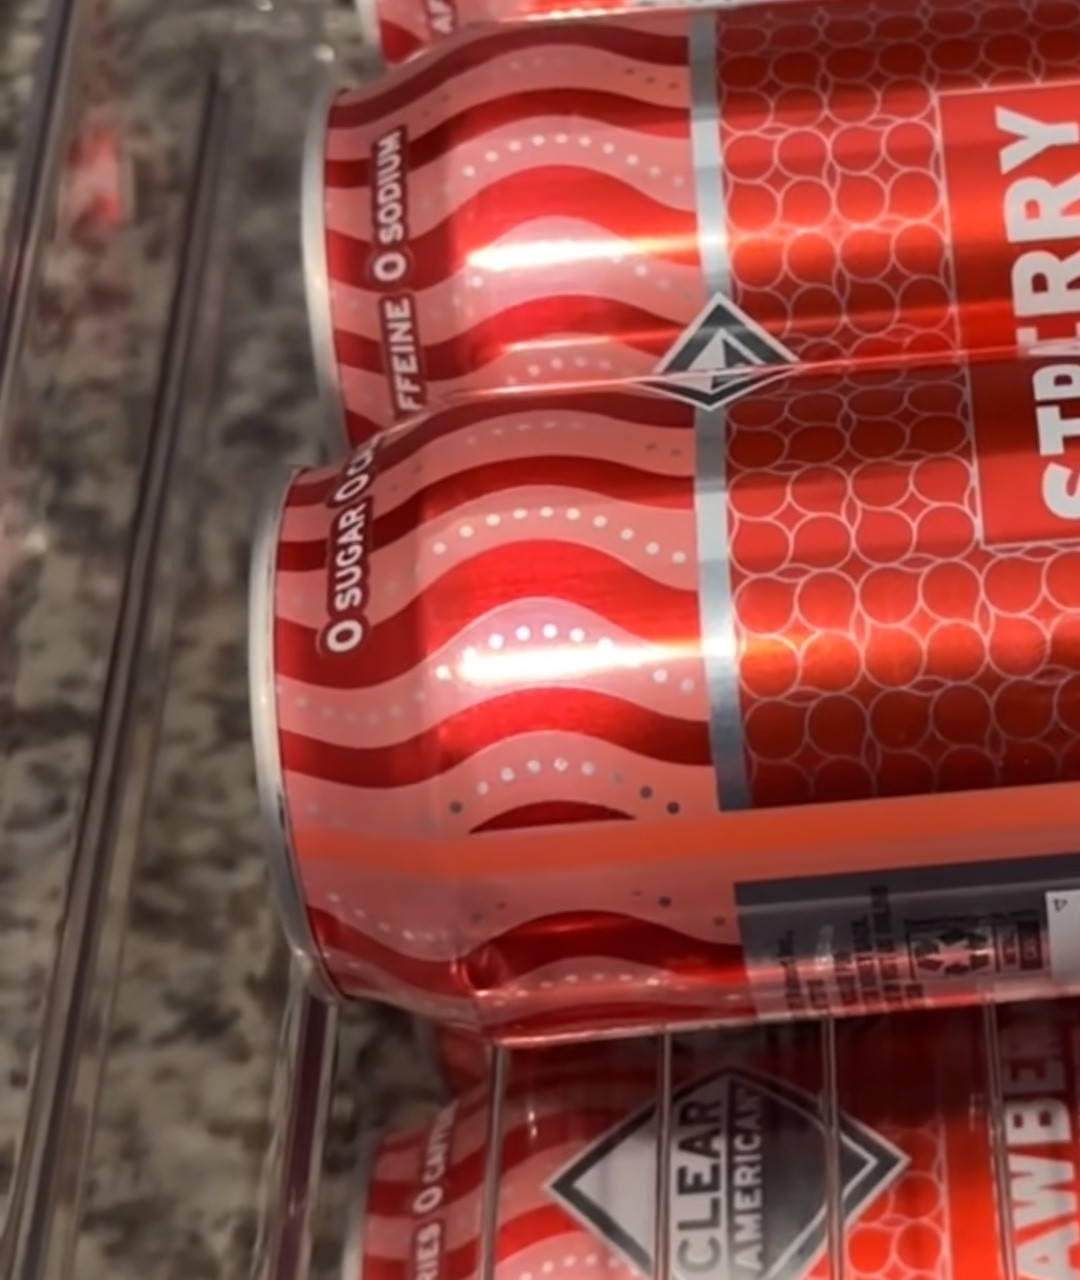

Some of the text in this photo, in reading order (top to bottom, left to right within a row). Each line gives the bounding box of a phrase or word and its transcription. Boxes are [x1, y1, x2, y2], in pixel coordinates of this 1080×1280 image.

[375, 130, 405, 243] SODIUM
[334, 503, 367, 611] SUGAR
[1053, 897, 1069, 912] 4
[676, 1099, 722, 1273] CLEAR
